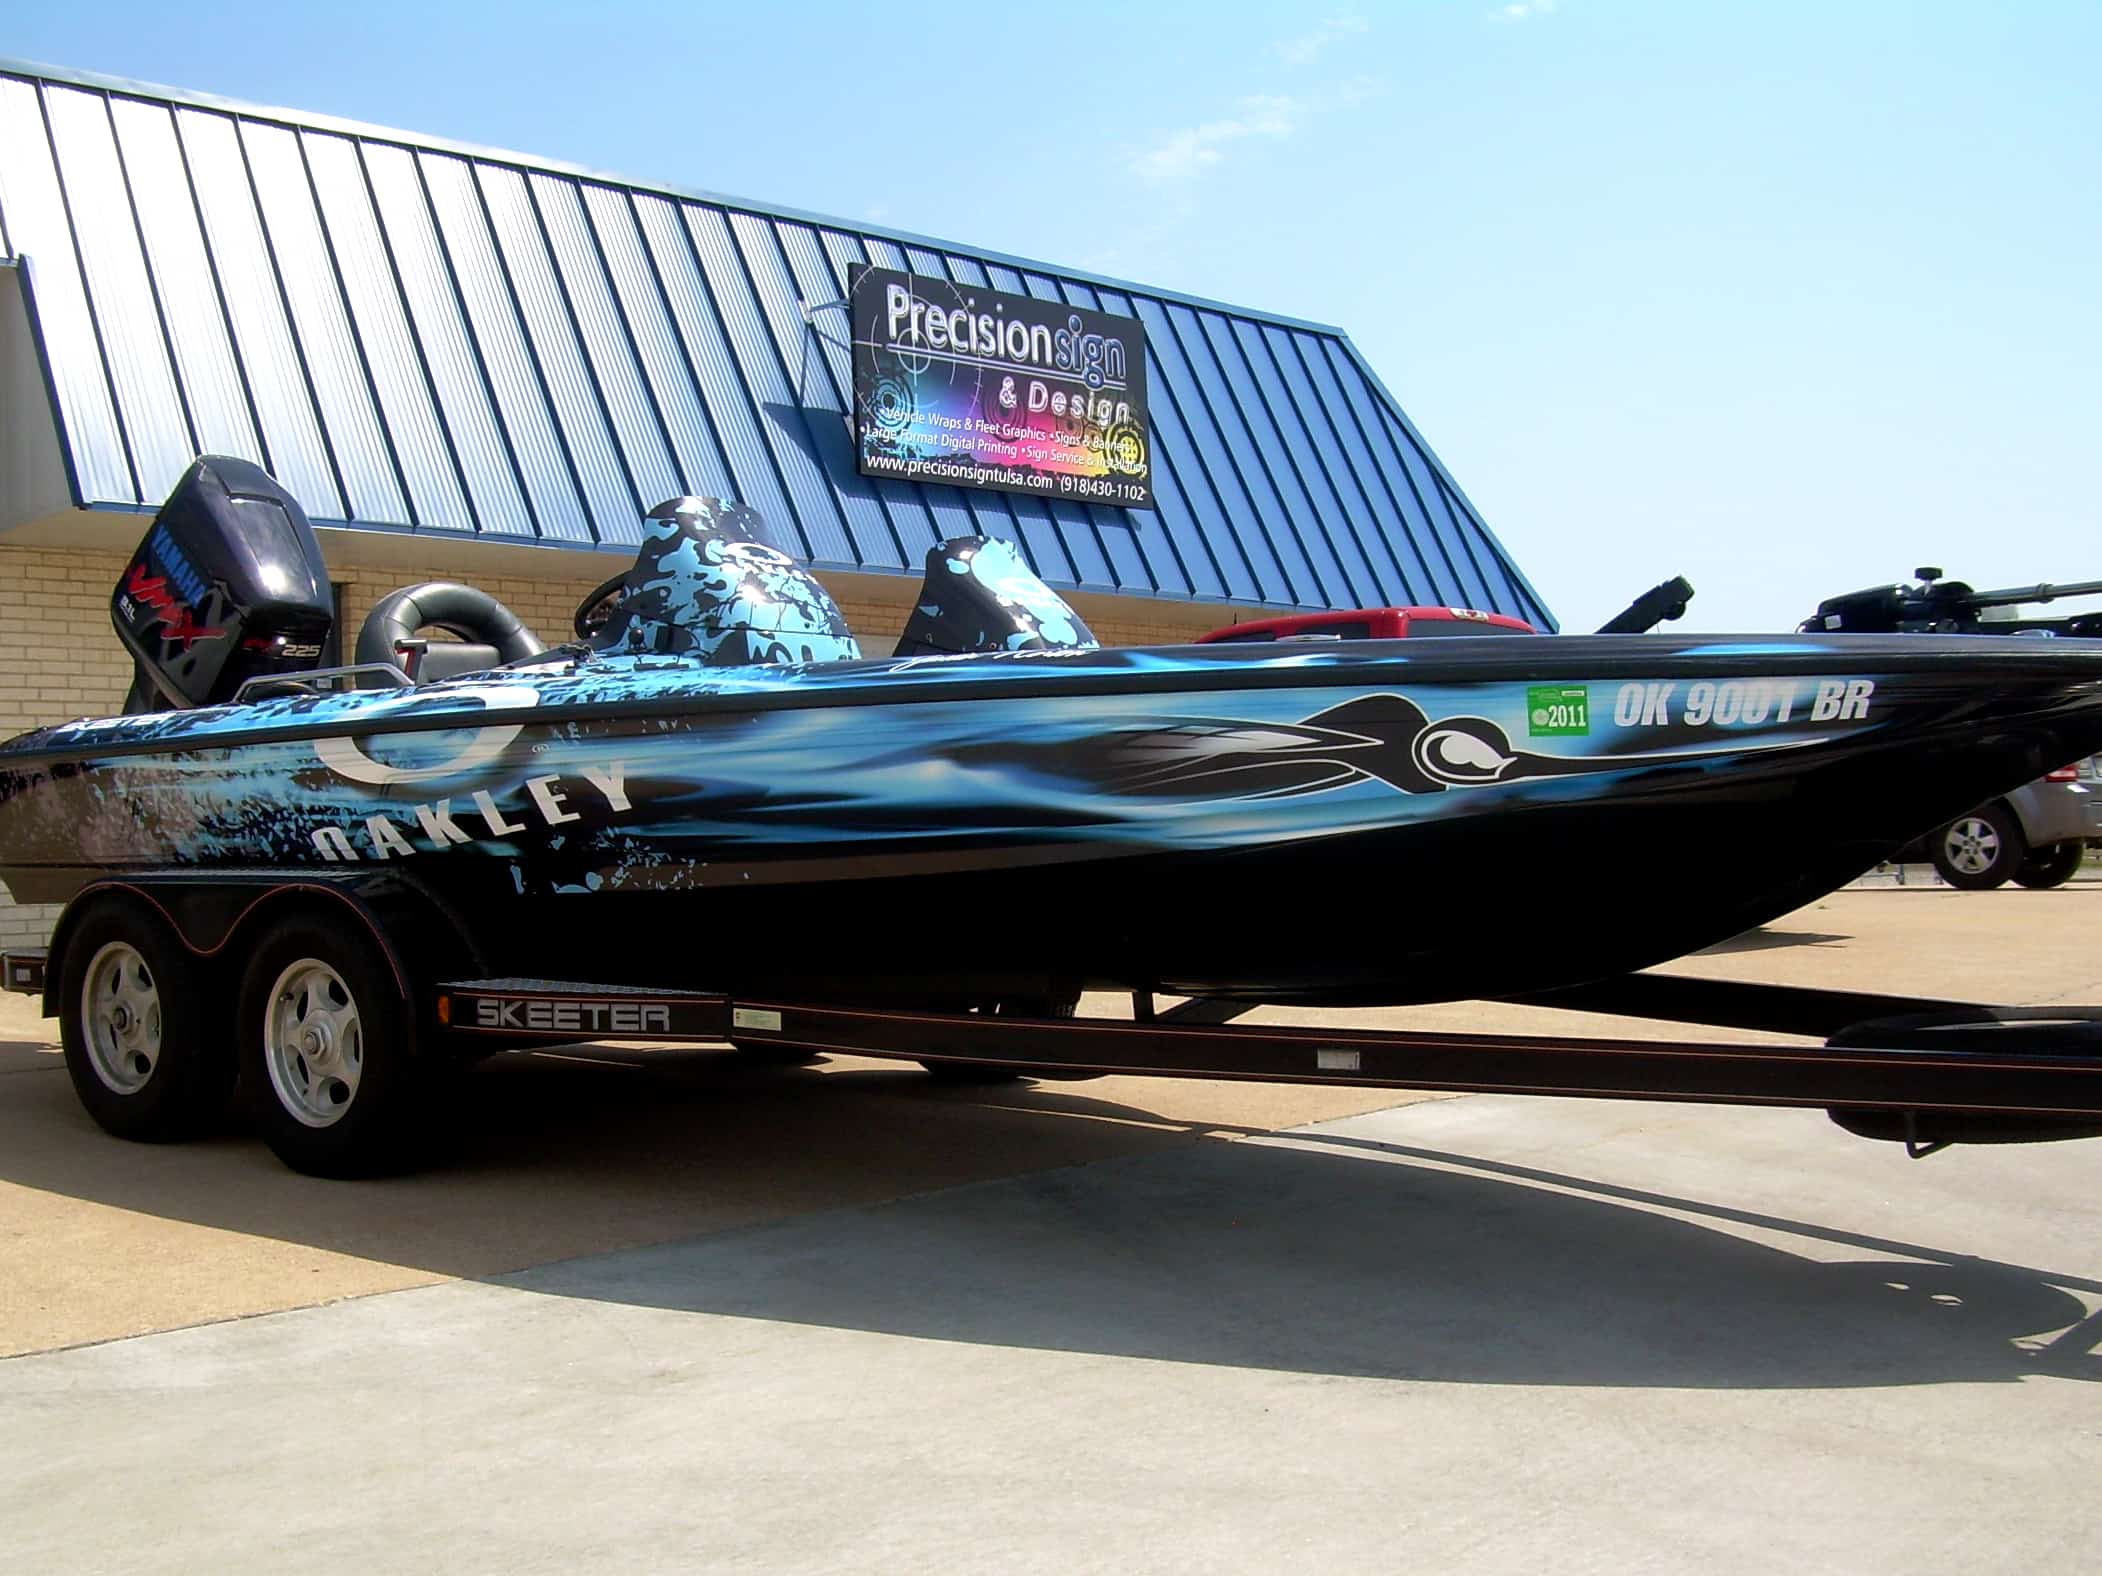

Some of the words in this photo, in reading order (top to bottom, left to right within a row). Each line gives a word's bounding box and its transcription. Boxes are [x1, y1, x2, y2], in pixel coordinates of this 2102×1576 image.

[999, 376, 1017, 408] &
[1029, 381, 1130, 429] Design
[867, 422, 897, 442] Large
[900, 428, 938, 445] Format
[941, 434, 975, 451] Digital
[978, 439, 1017, 458] Printing
[1026, 446, 1048, 460] Sign
[1051, 448, 1085, 465] Service
[886, 406, 926, 425] Vehicle
[928, 412, 962, 431] Wraps
[964, 418, 973, 431] &
[975, 419, 1001, 435] Fleet
[1002, 423, 1046, 440] Graphics
[1055, 431, 1080, 446] Signs
[1082, 437, 1090, 447] &
[866, 455, 1053, 489] www.precisionsigntulsa.com
[1061, 475, 1145, 501] (918)430-1102
[152, 524, 208, 609] YAMAHA
[281, 644, 321, 657] 225
[1548, 704, 1587, 727] 2011
[1614, 683, 1677, 726] OK
[1683, 680, 1798, 726] 9001
[1811, 679, 1875, 722] BR
[311, 761, 632, 861] OAKLEY
[477, 999, 670, 1032] SKEETER
